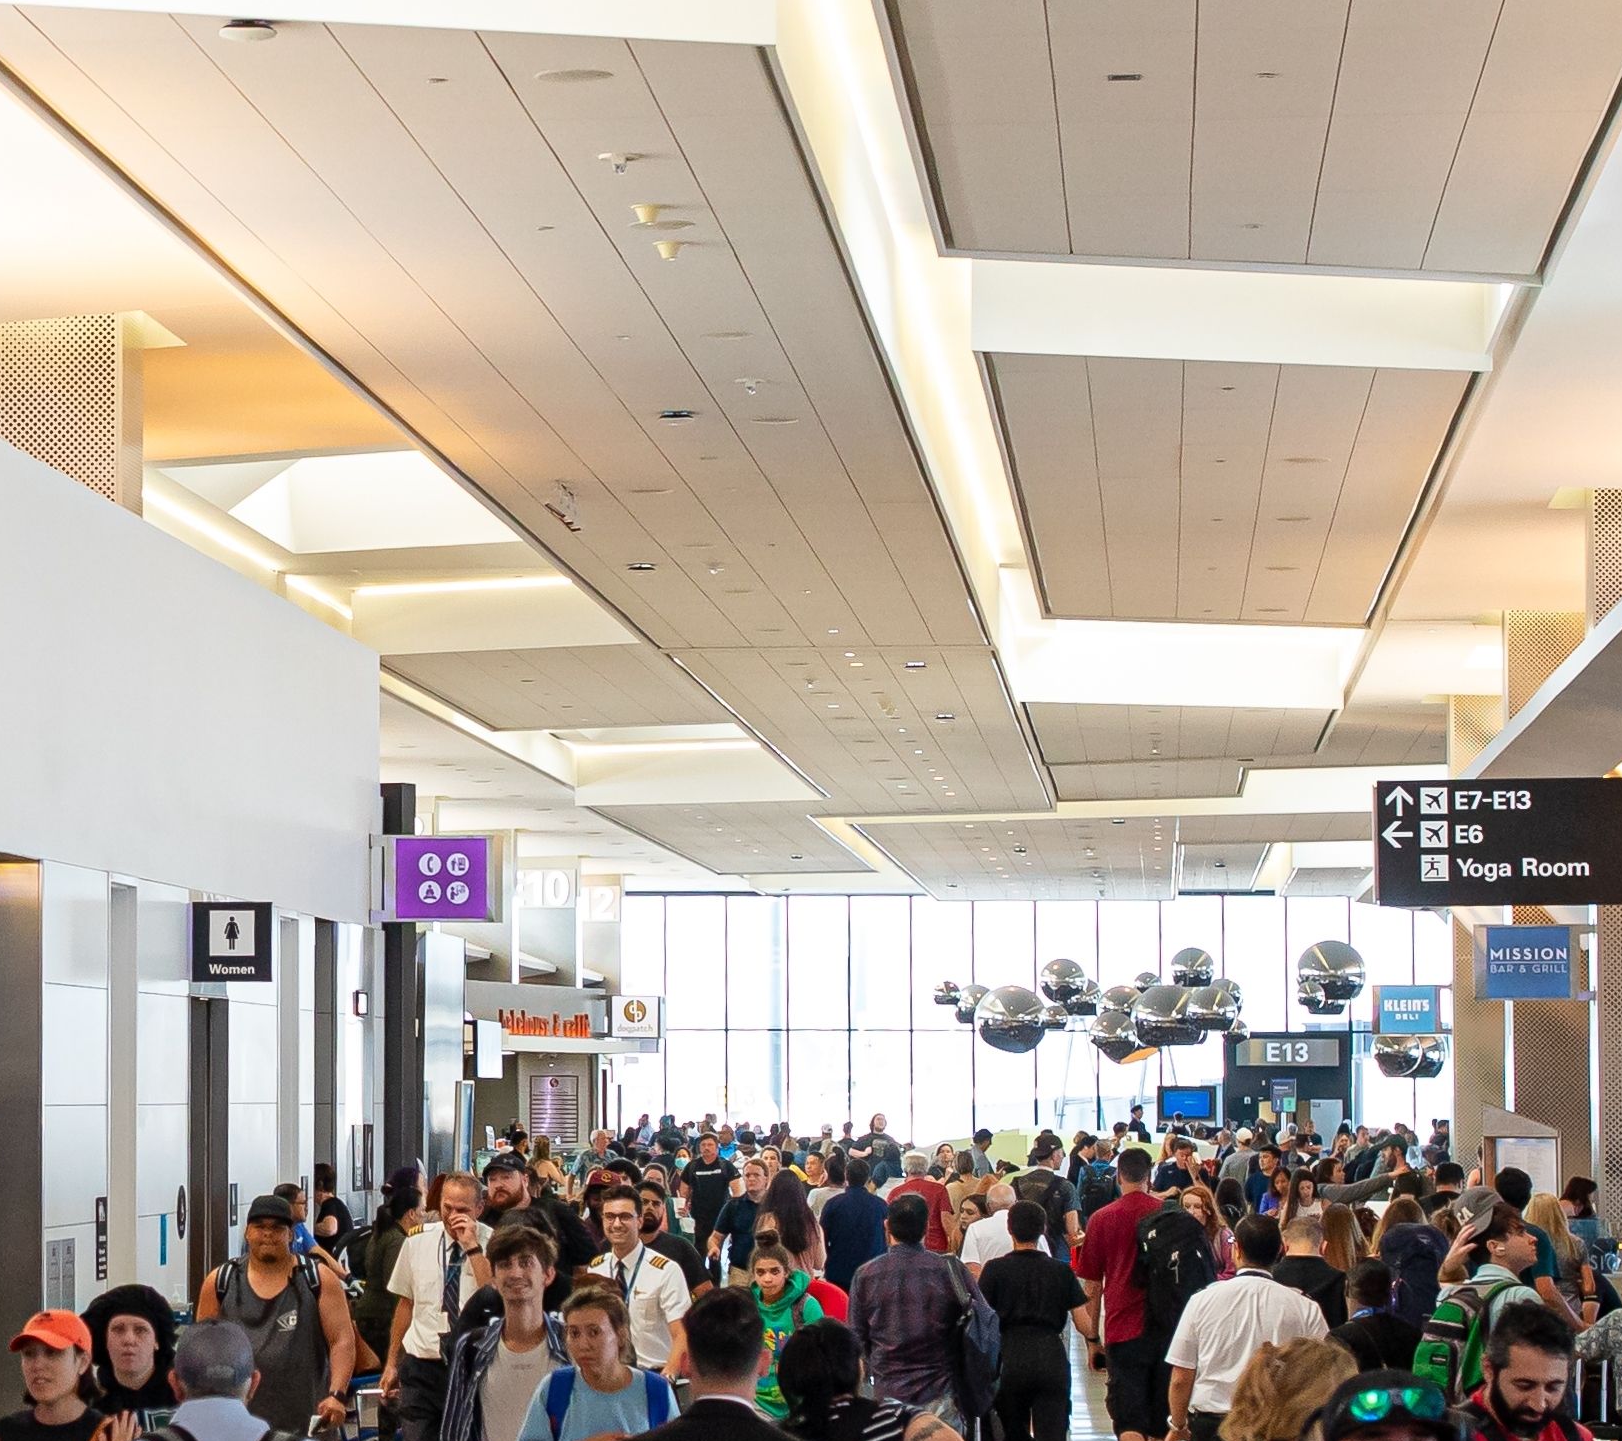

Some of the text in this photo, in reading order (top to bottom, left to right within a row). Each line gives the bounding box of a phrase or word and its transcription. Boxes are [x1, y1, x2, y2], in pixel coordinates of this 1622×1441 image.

[1454, 790, 1532, 810] E7-E13
[1454, 824, 1484, 845] E6
[1456, 858, 1590, 882] Yoga Room
[1489, 948, 1567, 961] MISSION
[208, 963, 256, 975] Women
[1489, 964, 1567, 974] BAR & GRILL
[1383, 999, 1430, 1012] KLEIN'S
[616, 1024, 654, 1033] dogpatch
[1265, 1042, 1310, 1063] E13
